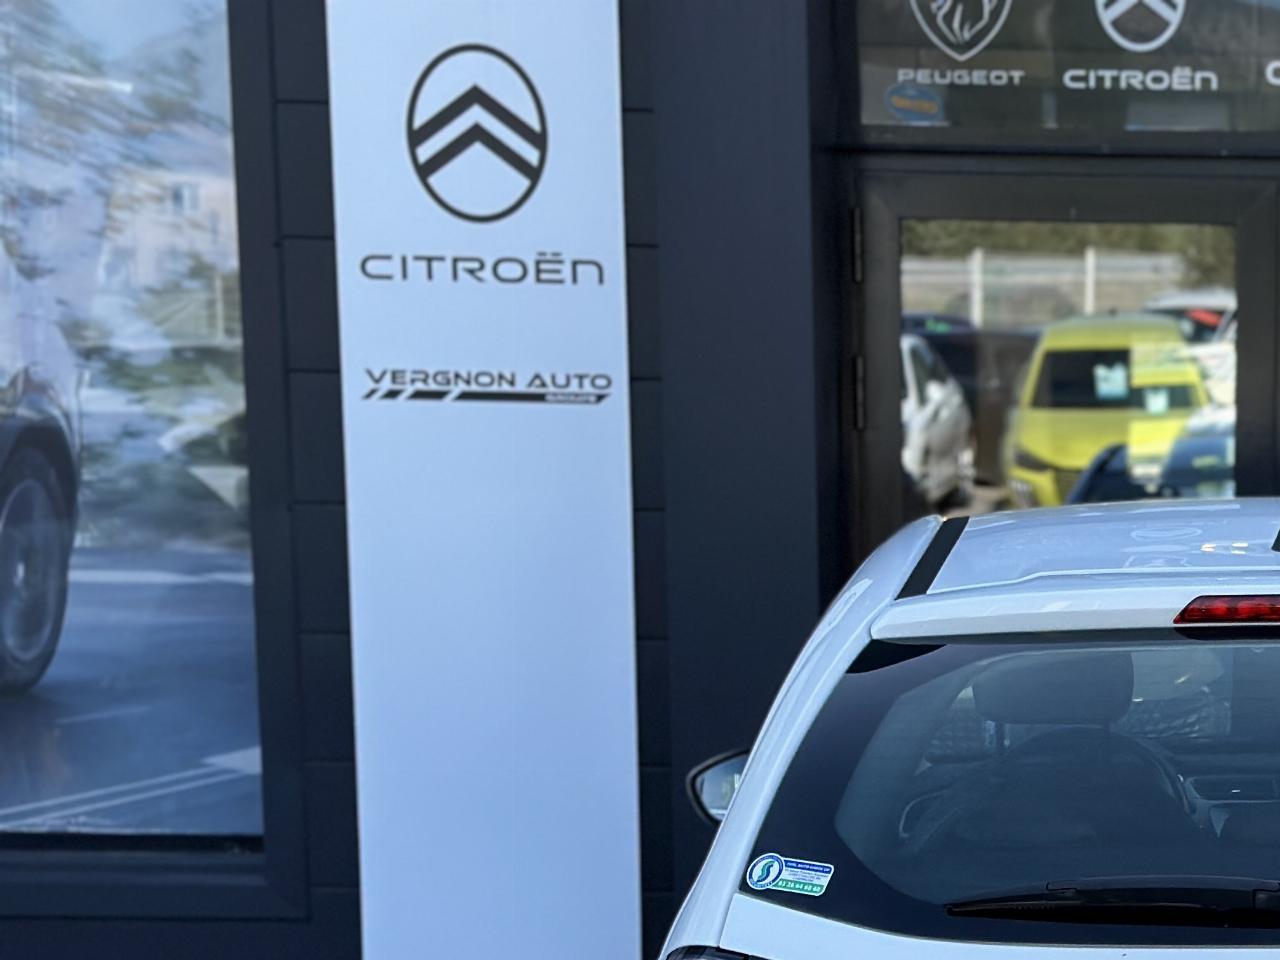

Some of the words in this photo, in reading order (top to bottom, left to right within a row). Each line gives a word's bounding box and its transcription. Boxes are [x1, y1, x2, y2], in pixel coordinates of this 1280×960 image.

[897, 68, 1026, 86] PEUGEOT
[364, 368, 516, 388] VERGNON
[525, 372, 613, 391] AUTO
